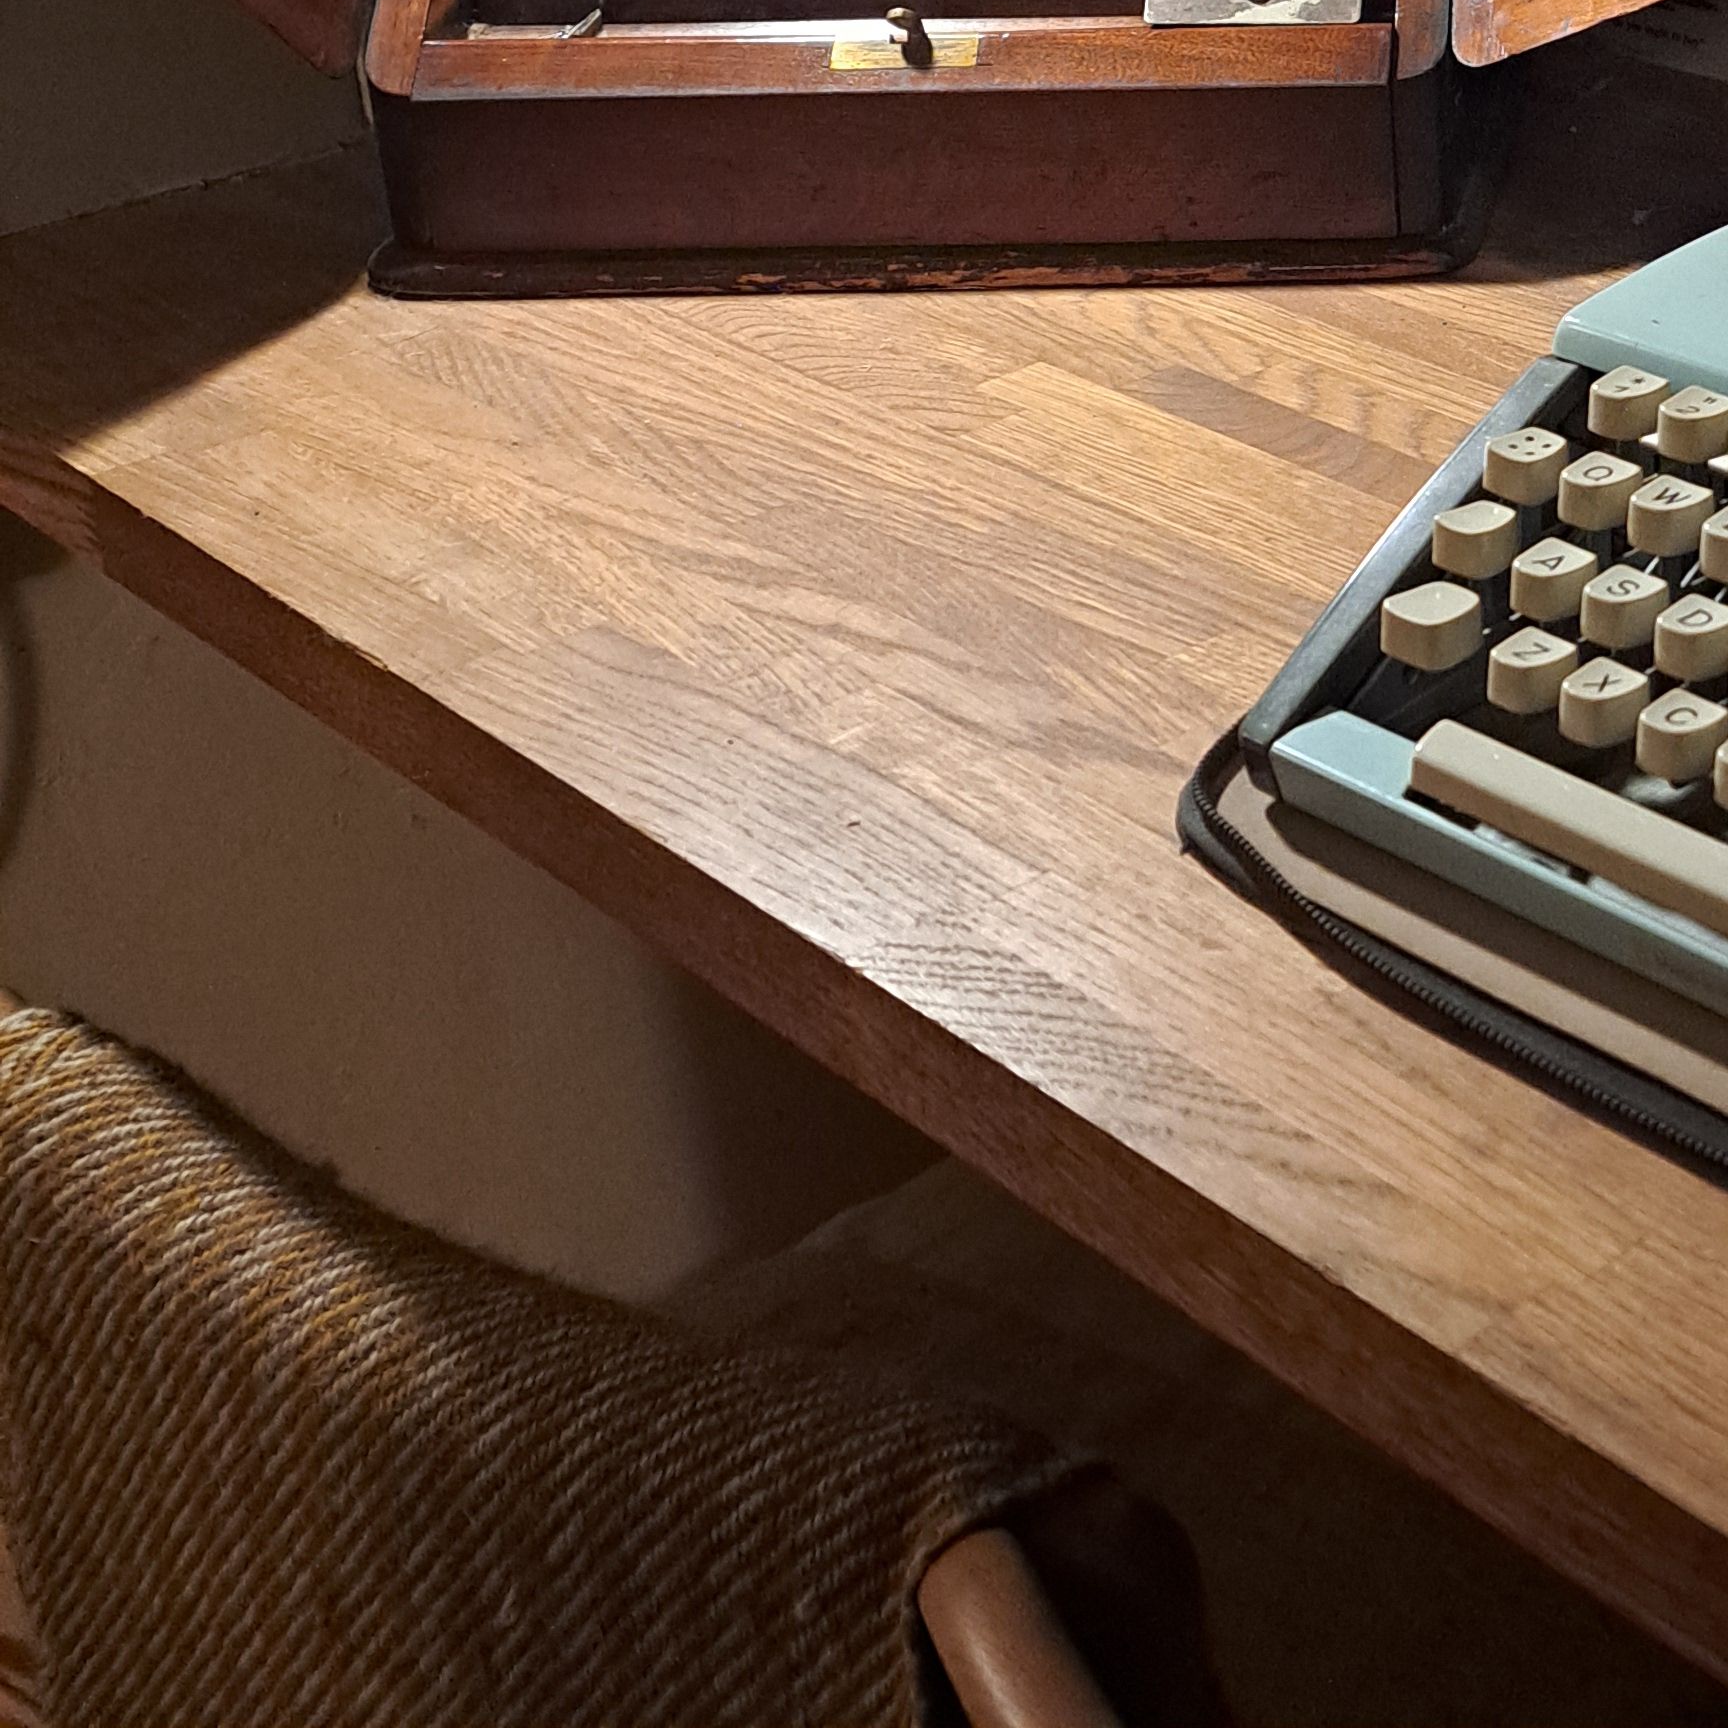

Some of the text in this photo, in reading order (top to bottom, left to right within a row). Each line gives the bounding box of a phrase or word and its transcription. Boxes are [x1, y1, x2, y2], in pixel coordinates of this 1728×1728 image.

[1652, 487, 1691, 504] W
[1532, 555, 1565, 571] A
[1607, 579, 1640, 596] S
[1678, 608, 1713, 626] D
[1512, 642, 1551, 661] Z
[1582, 673, 1622, 692] X
[1665, 707, 1698, 725] C
